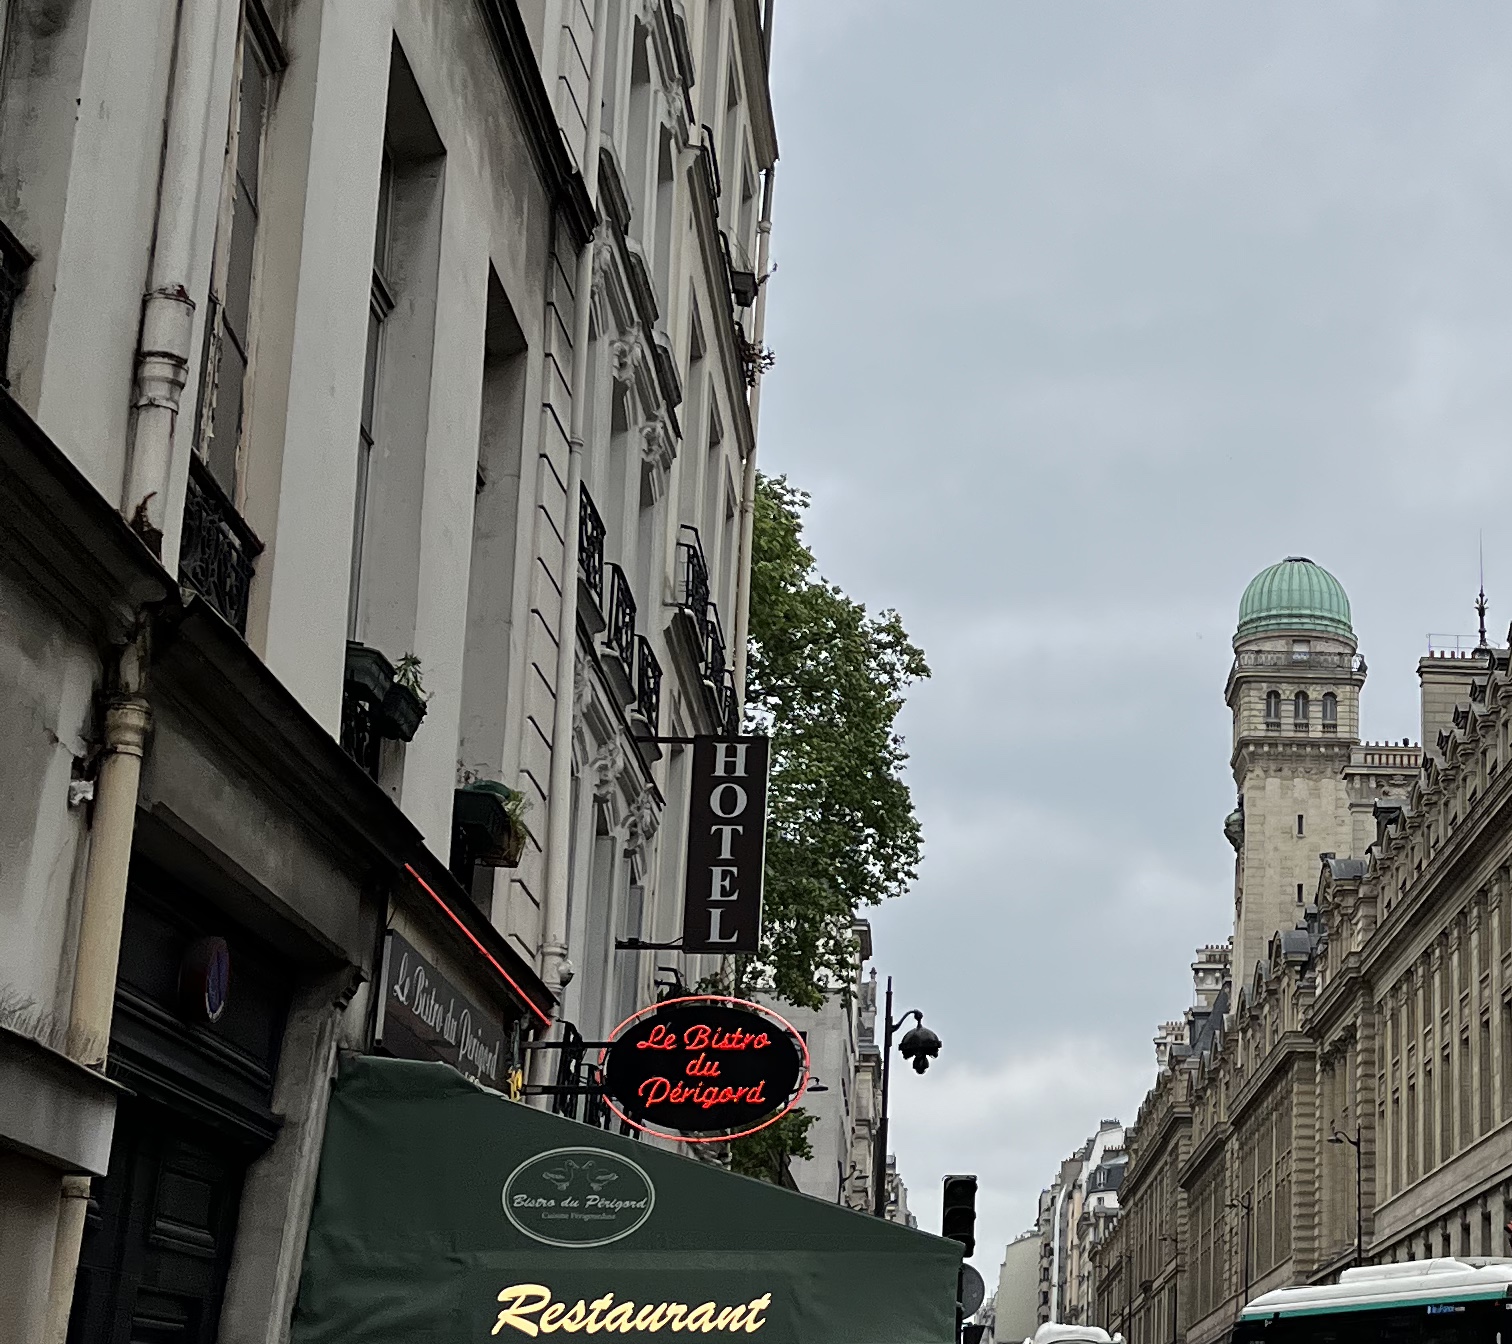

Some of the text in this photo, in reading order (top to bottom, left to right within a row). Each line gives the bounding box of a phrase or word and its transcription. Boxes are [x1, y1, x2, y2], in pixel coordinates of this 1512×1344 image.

[704, 742, 751, 944] HOTEL
[393, 952, 411, 1006] Le
[412, 965, 444, 1033] Bistro
[444, 998, 458, 1046] du
[636, 1024, 772, 1051] Le Bistro
[685, 1052, 721, 1077] du
[638, 1076, 766, 1109] Périgord
[513, 1194, 556, 1207] Bistro
[560, 1195, 580, 1208] du
[491, 1283, 772, 1337] Restaurant
